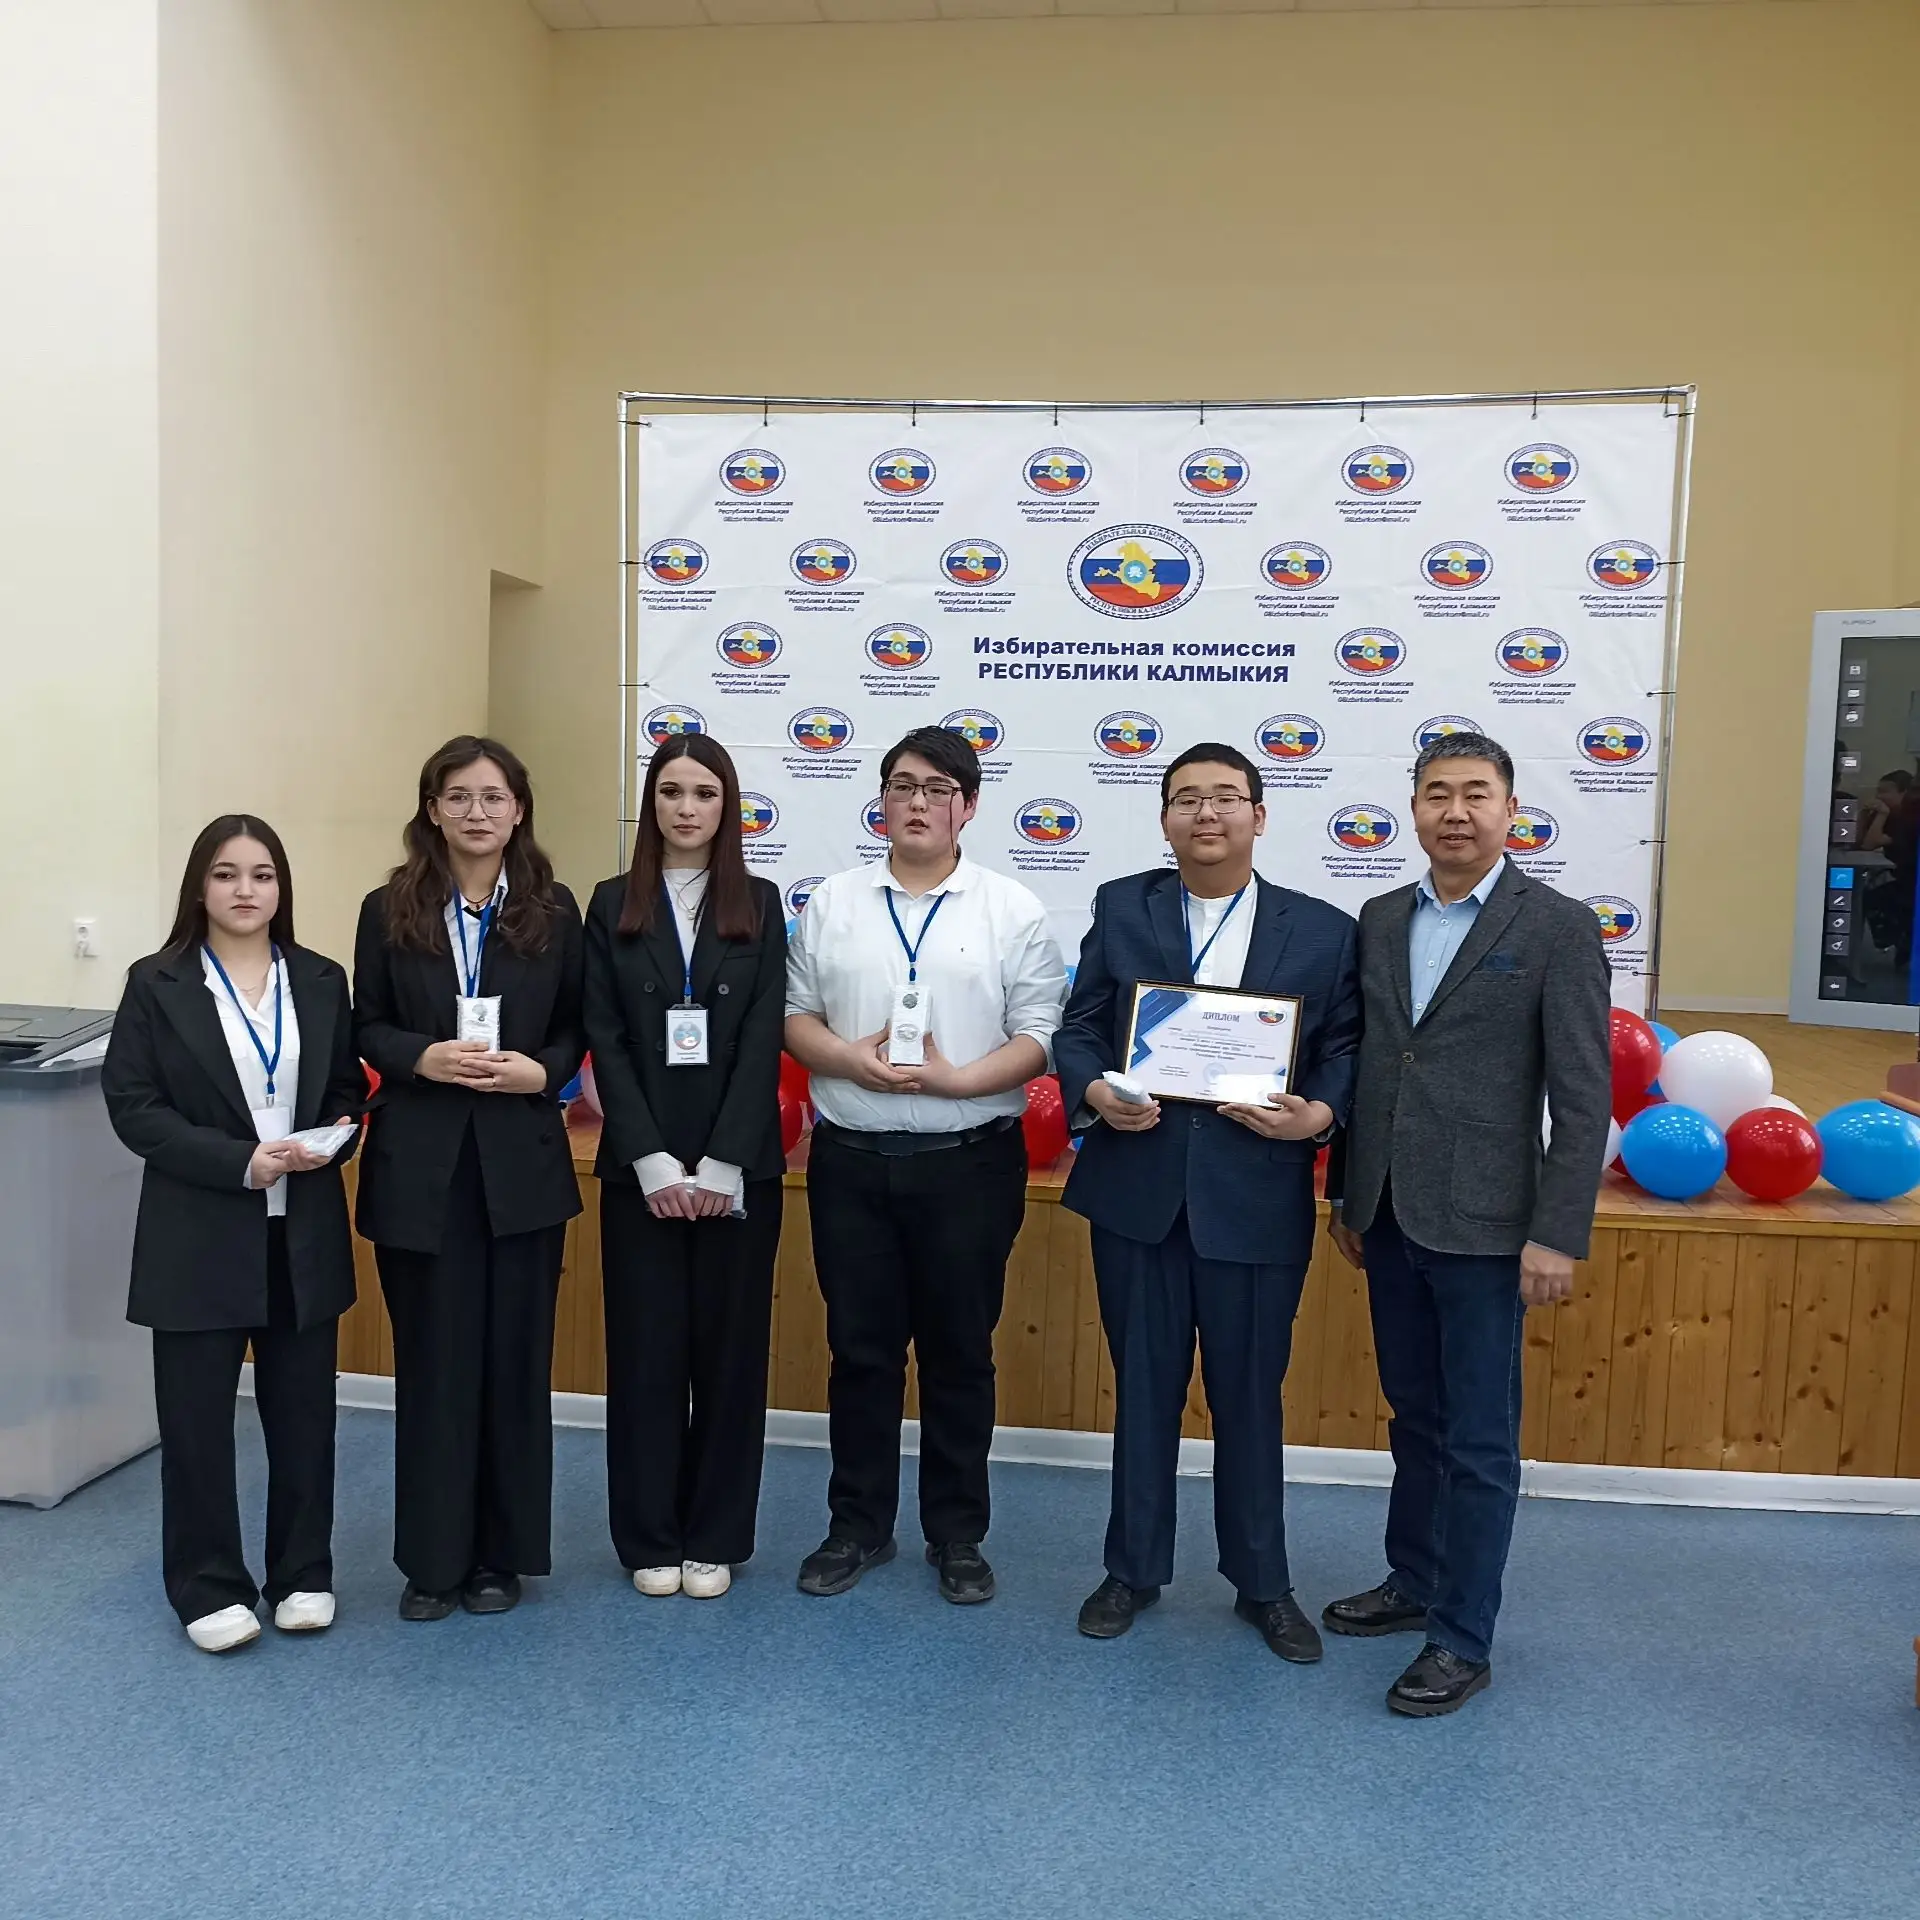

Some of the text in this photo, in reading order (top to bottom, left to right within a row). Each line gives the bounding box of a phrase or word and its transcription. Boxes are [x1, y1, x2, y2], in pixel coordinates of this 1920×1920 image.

[974, 637, 1295, 658] Избирательная комиссия
[979, 663, 1288, 682] РЕСПУБЛИКИ КАЛМЫКИЯ
[1202, 1012, 1240, 1022] ДИПЛОМ
